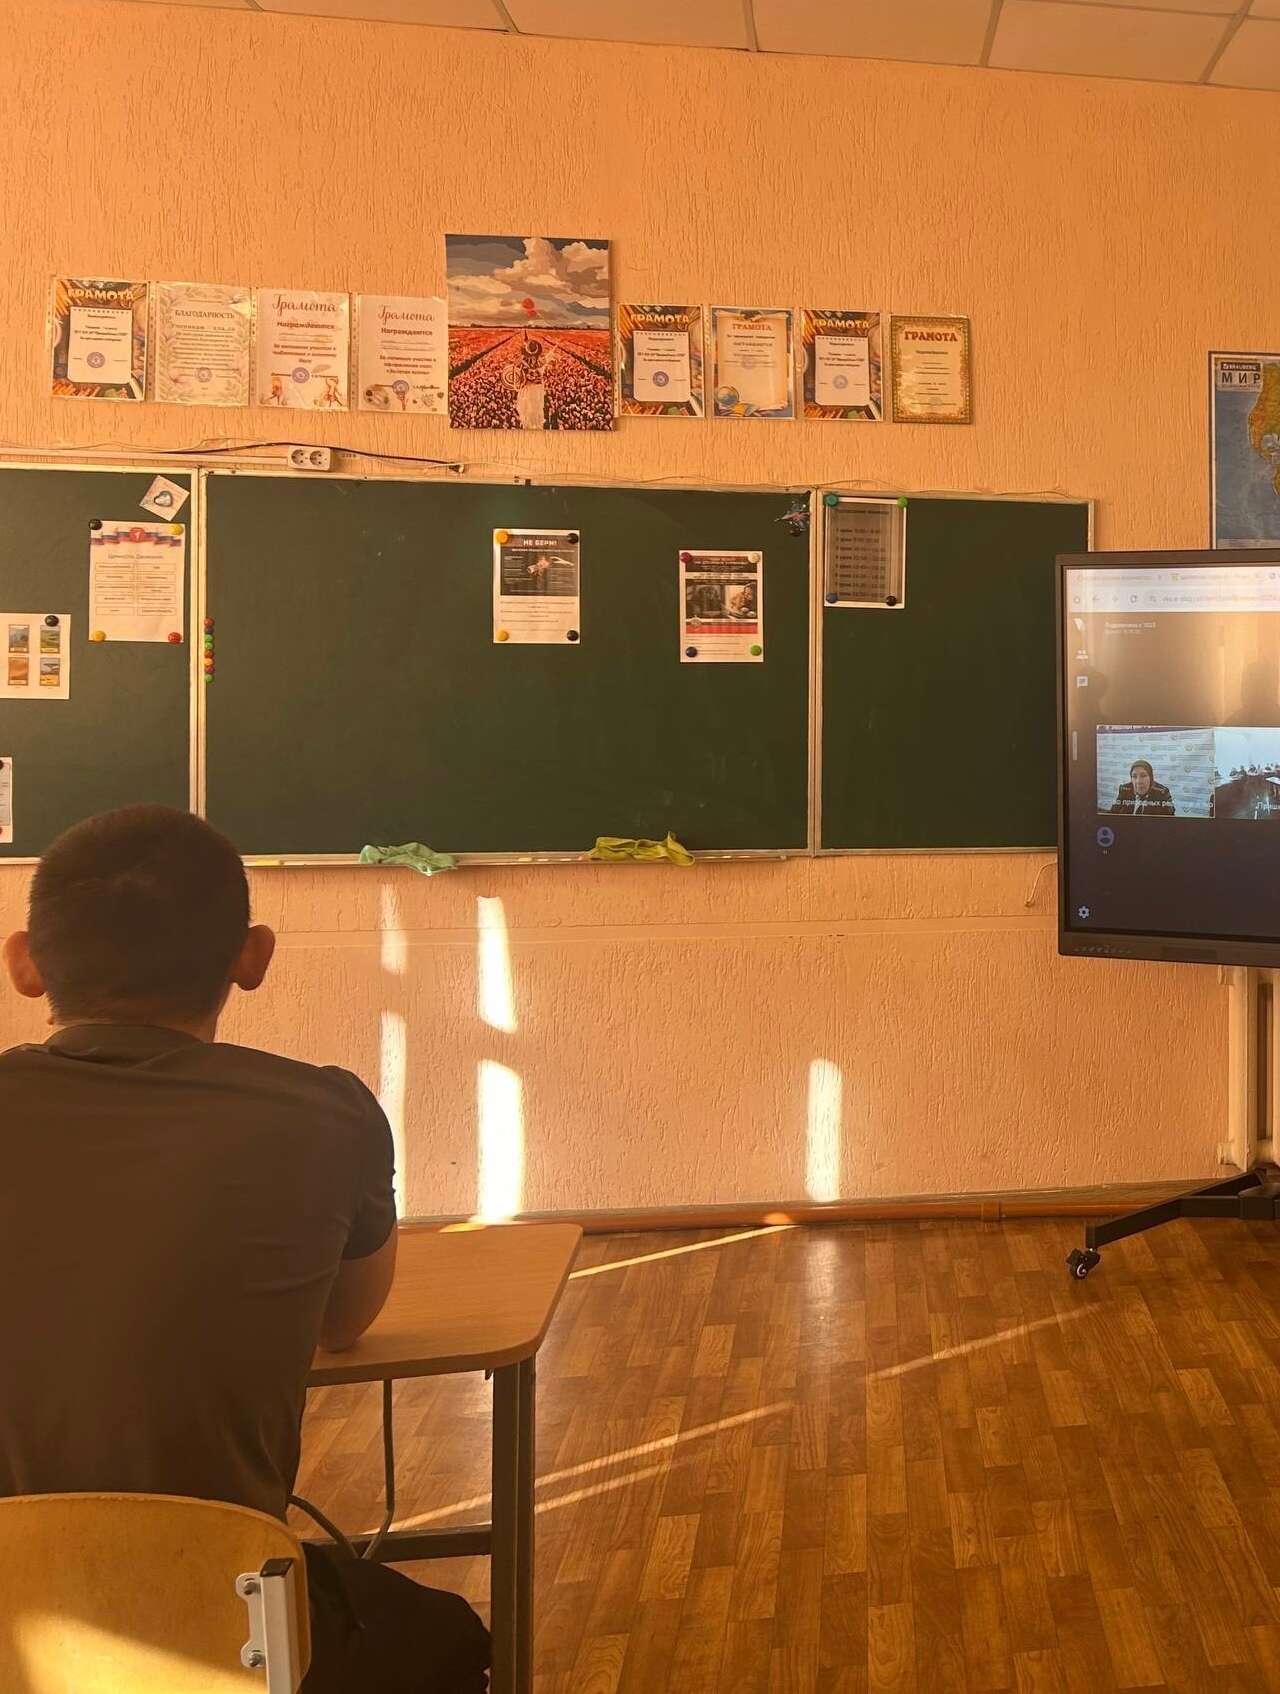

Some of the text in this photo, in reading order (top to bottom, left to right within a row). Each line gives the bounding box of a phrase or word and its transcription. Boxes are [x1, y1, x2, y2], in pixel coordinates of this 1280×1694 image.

[68, 288, 135, 301] ГРАМОТА
[271, 294, 337, 316] Грамота
[175, 309, 235, 320] БЛАГОДАРНОСТЬ
[377, 304, 435, 324] Грамота
[630, 313, 690, 324] ГРАМОТА
[813, 318, 870, 329] ГРАМОТА
[904, 330, 959, 342] ГРАМОТА
[1221, 372, 1261, 384] МИР
